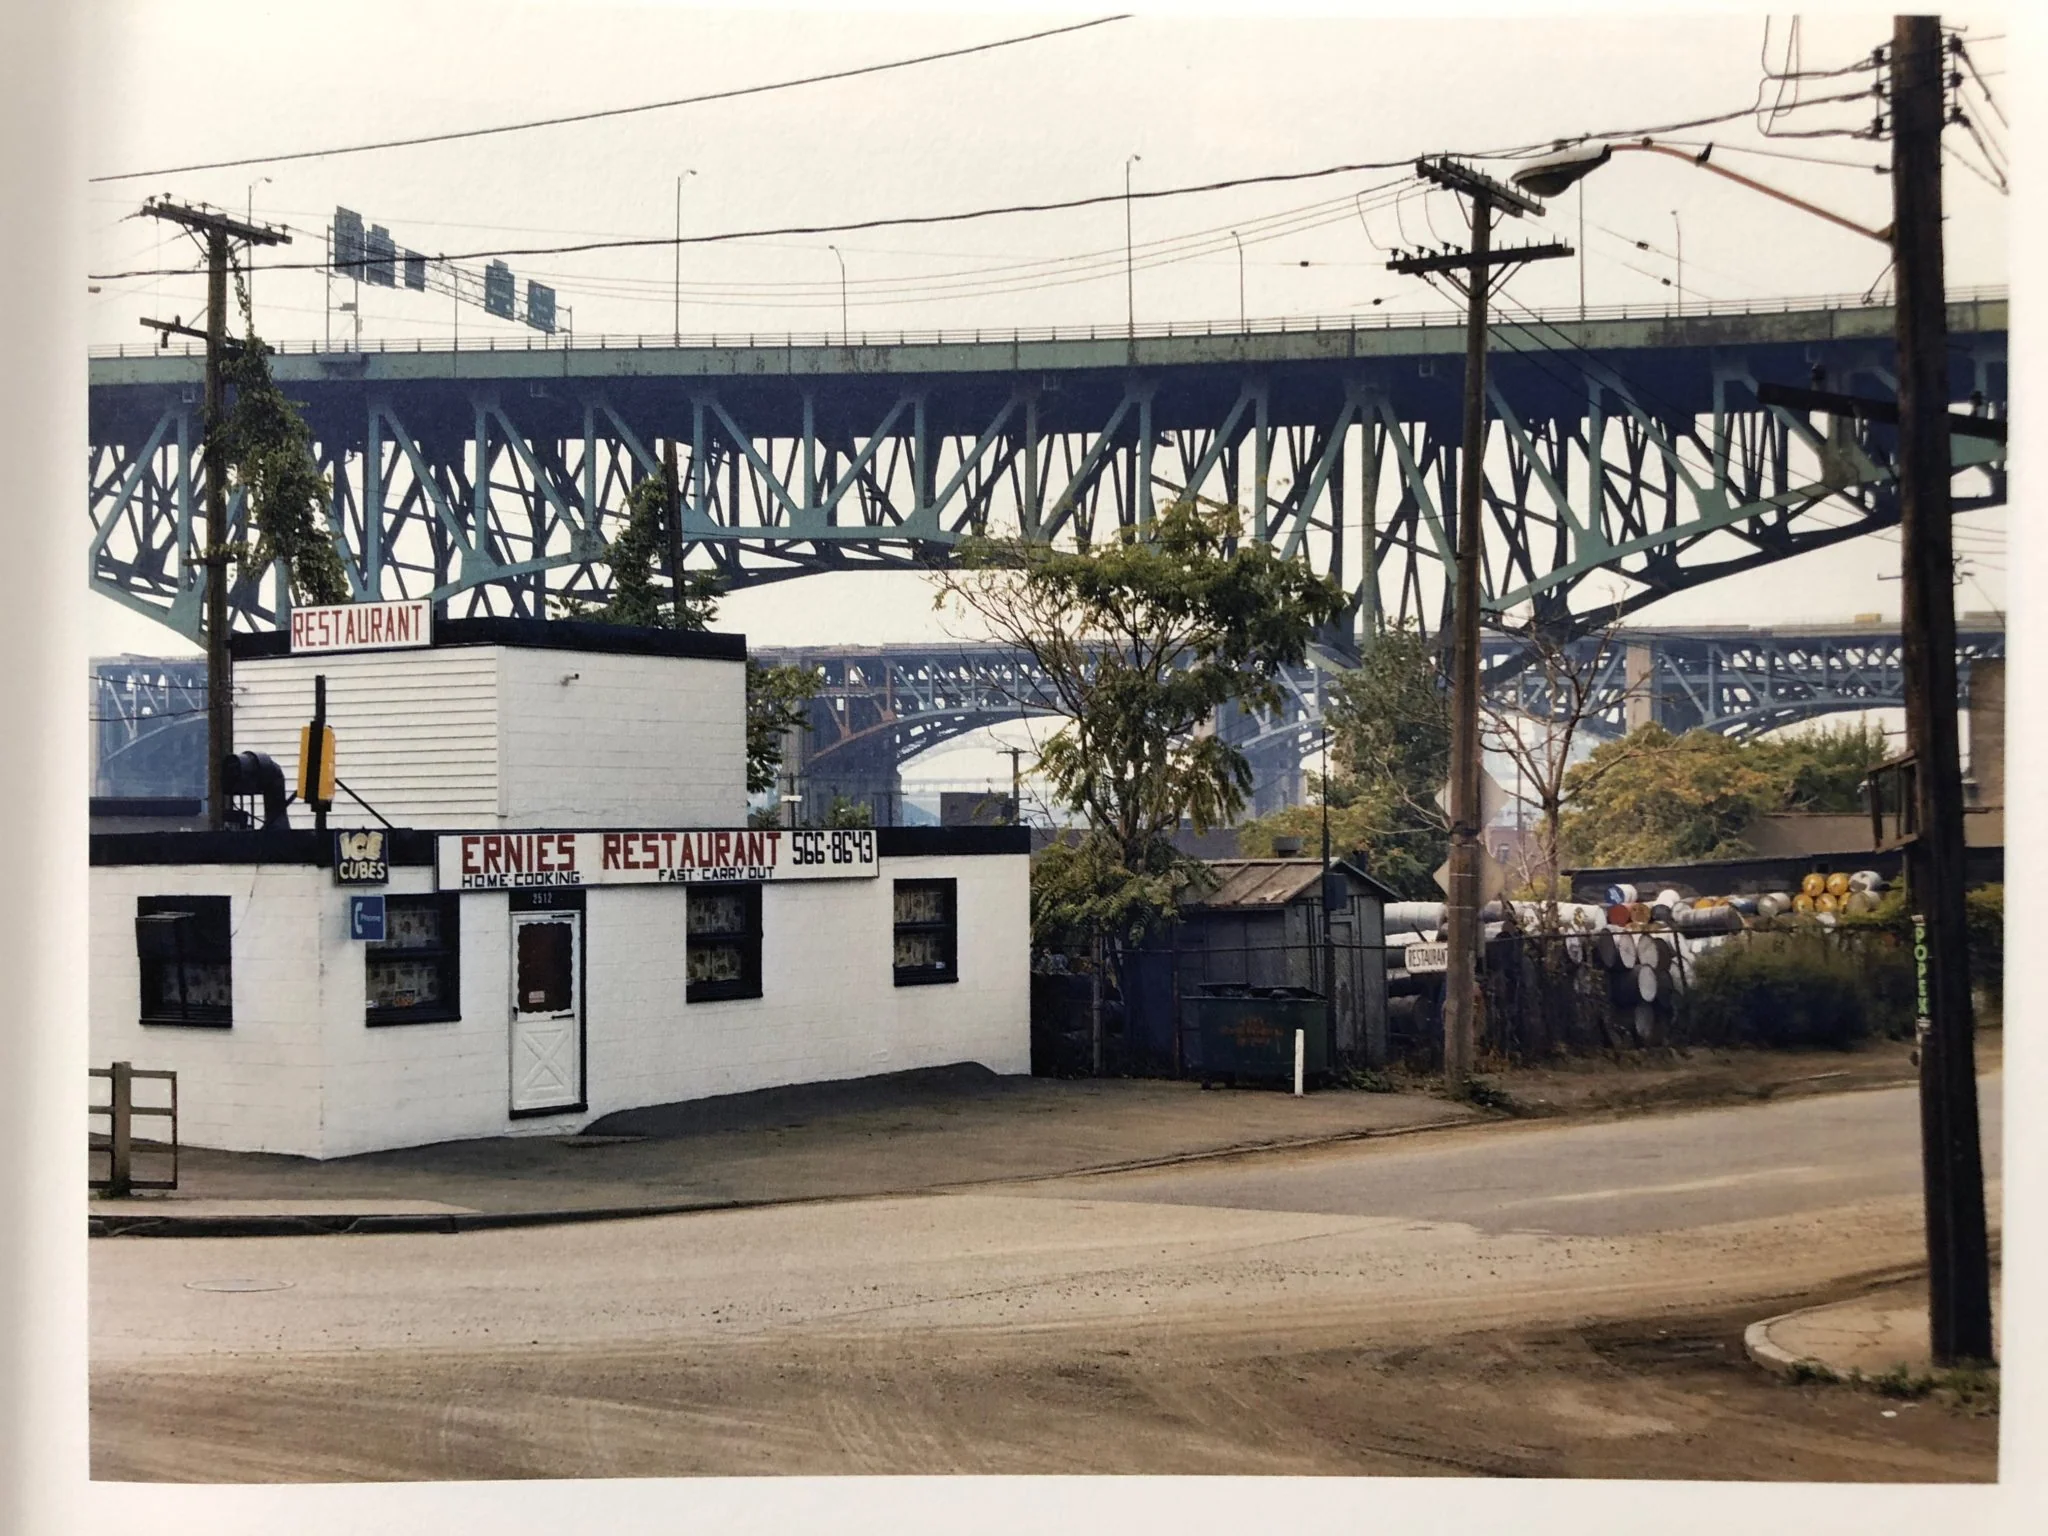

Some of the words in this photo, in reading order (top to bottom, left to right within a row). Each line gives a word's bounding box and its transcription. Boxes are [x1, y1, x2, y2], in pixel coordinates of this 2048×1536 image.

[293, 605, 422, 647] RESTAURANT
[339, 831, 383, 861] ICE
[461, 834, 575, 874] ERNIES
[603, 833, 781, 870] RESTAURANT
[339, 861, 385, 879] CUBES
[658, 868, 694, 881] FAST
[702, 866, 744, 880] CARRY
[748, 866, 775, 879] OUT
